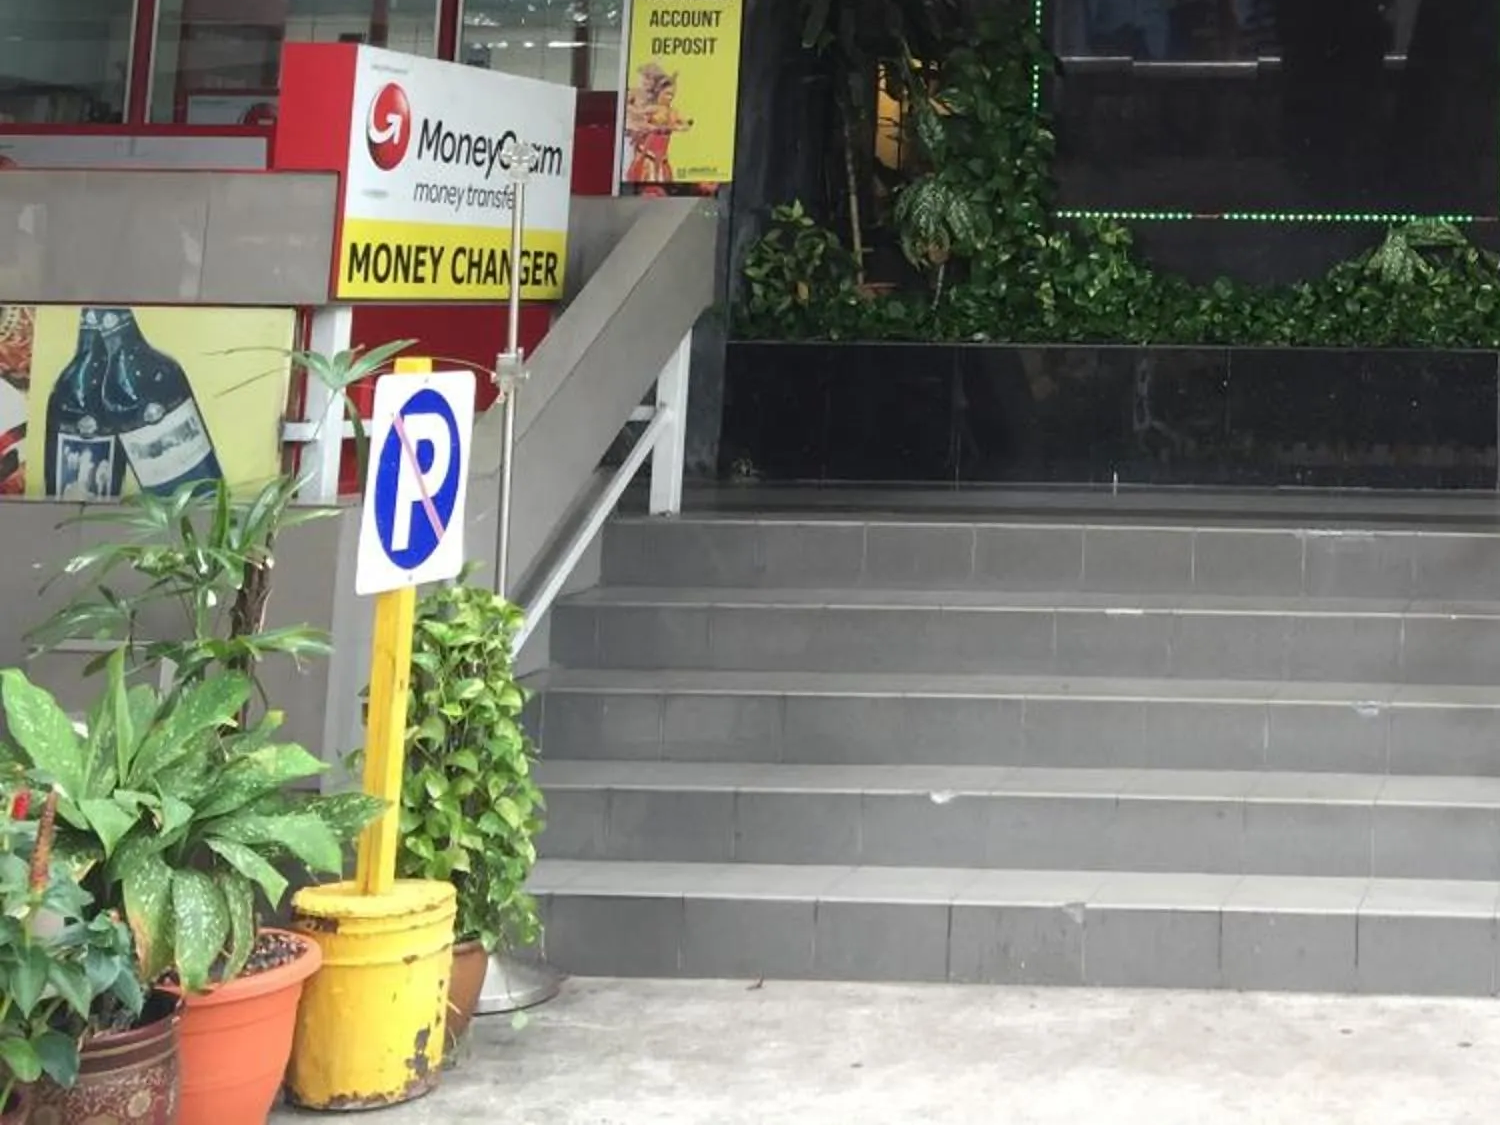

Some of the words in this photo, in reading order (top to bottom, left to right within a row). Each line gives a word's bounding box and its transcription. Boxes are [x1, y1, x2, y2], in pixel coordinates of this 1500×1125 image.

[649, 10, 722, 28] ACCOUNT
[651, 37, 718, 55] DEPOSIT
[416, 117, 564, 180] MoneyGam
[413, 181, 465, 212] money
[467, 184, 518, 211] transfe
[347, 242, 445, 285] MONEY
[450, 244, 559, 288] CHANGER
